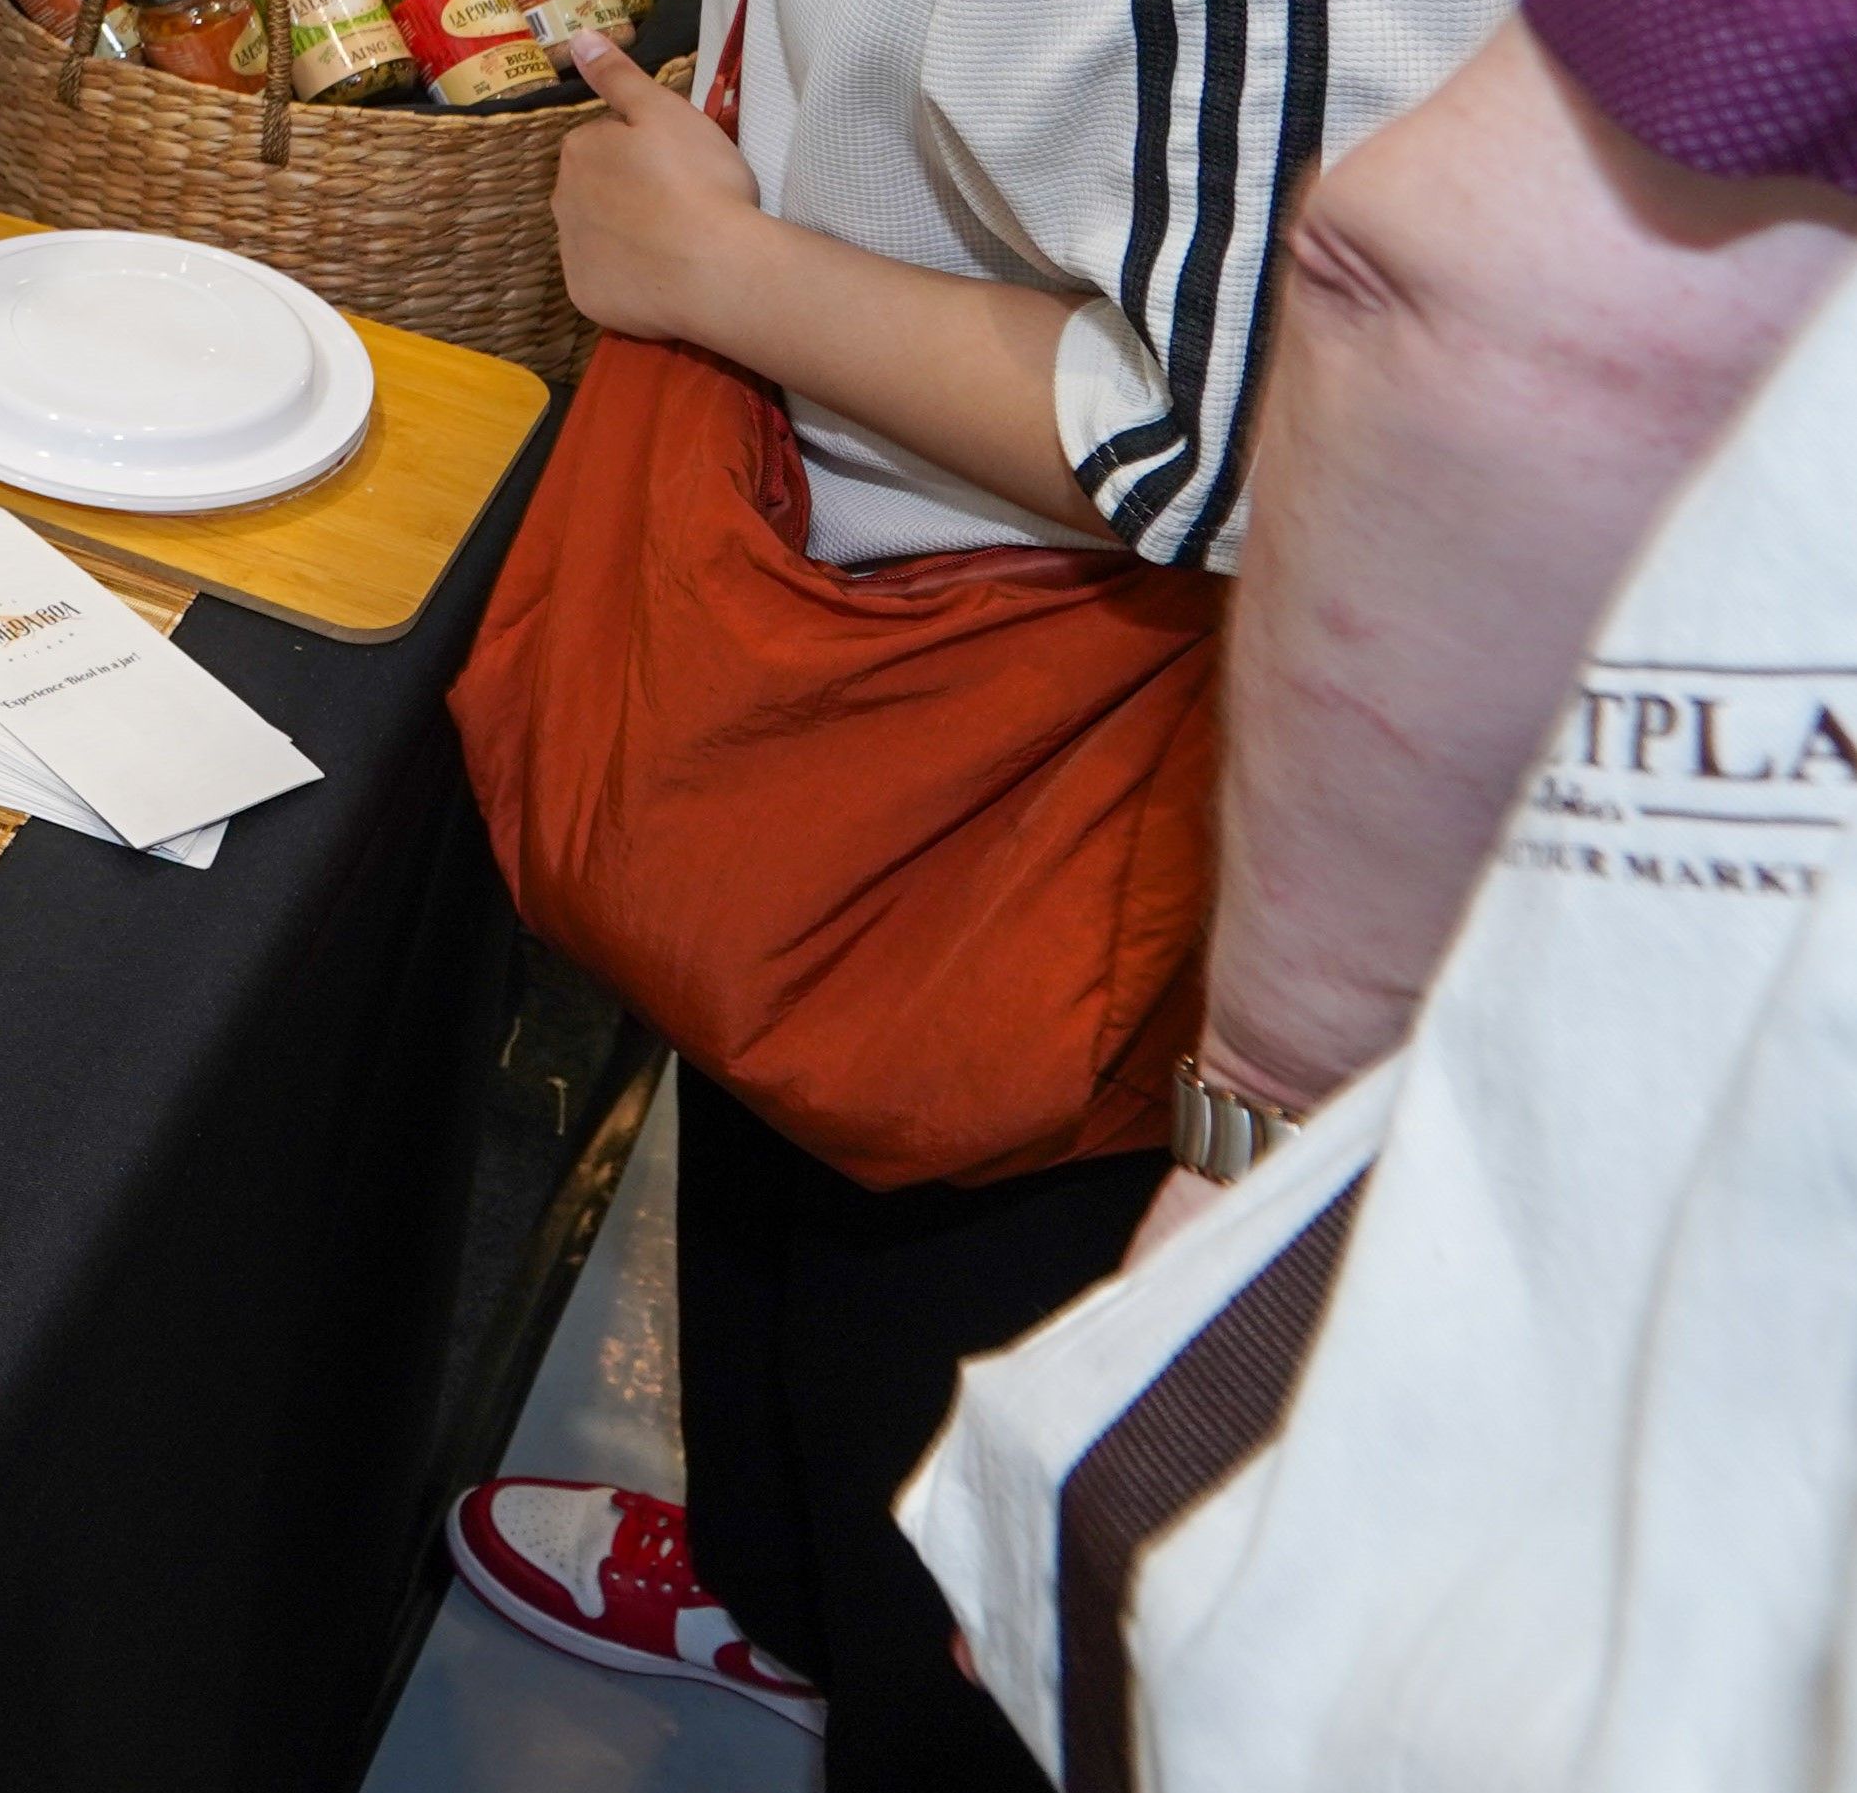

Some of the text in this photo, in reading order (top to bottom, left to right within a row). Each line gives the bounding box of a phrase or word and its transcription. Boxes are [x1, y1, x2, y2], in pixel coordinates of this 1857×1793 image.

[36, 600, 81, 626] GOA
[0, 681, 66, 710] Experience
[64, 668, 98, 686] Bicol
[97, 663, 111, 675] in
